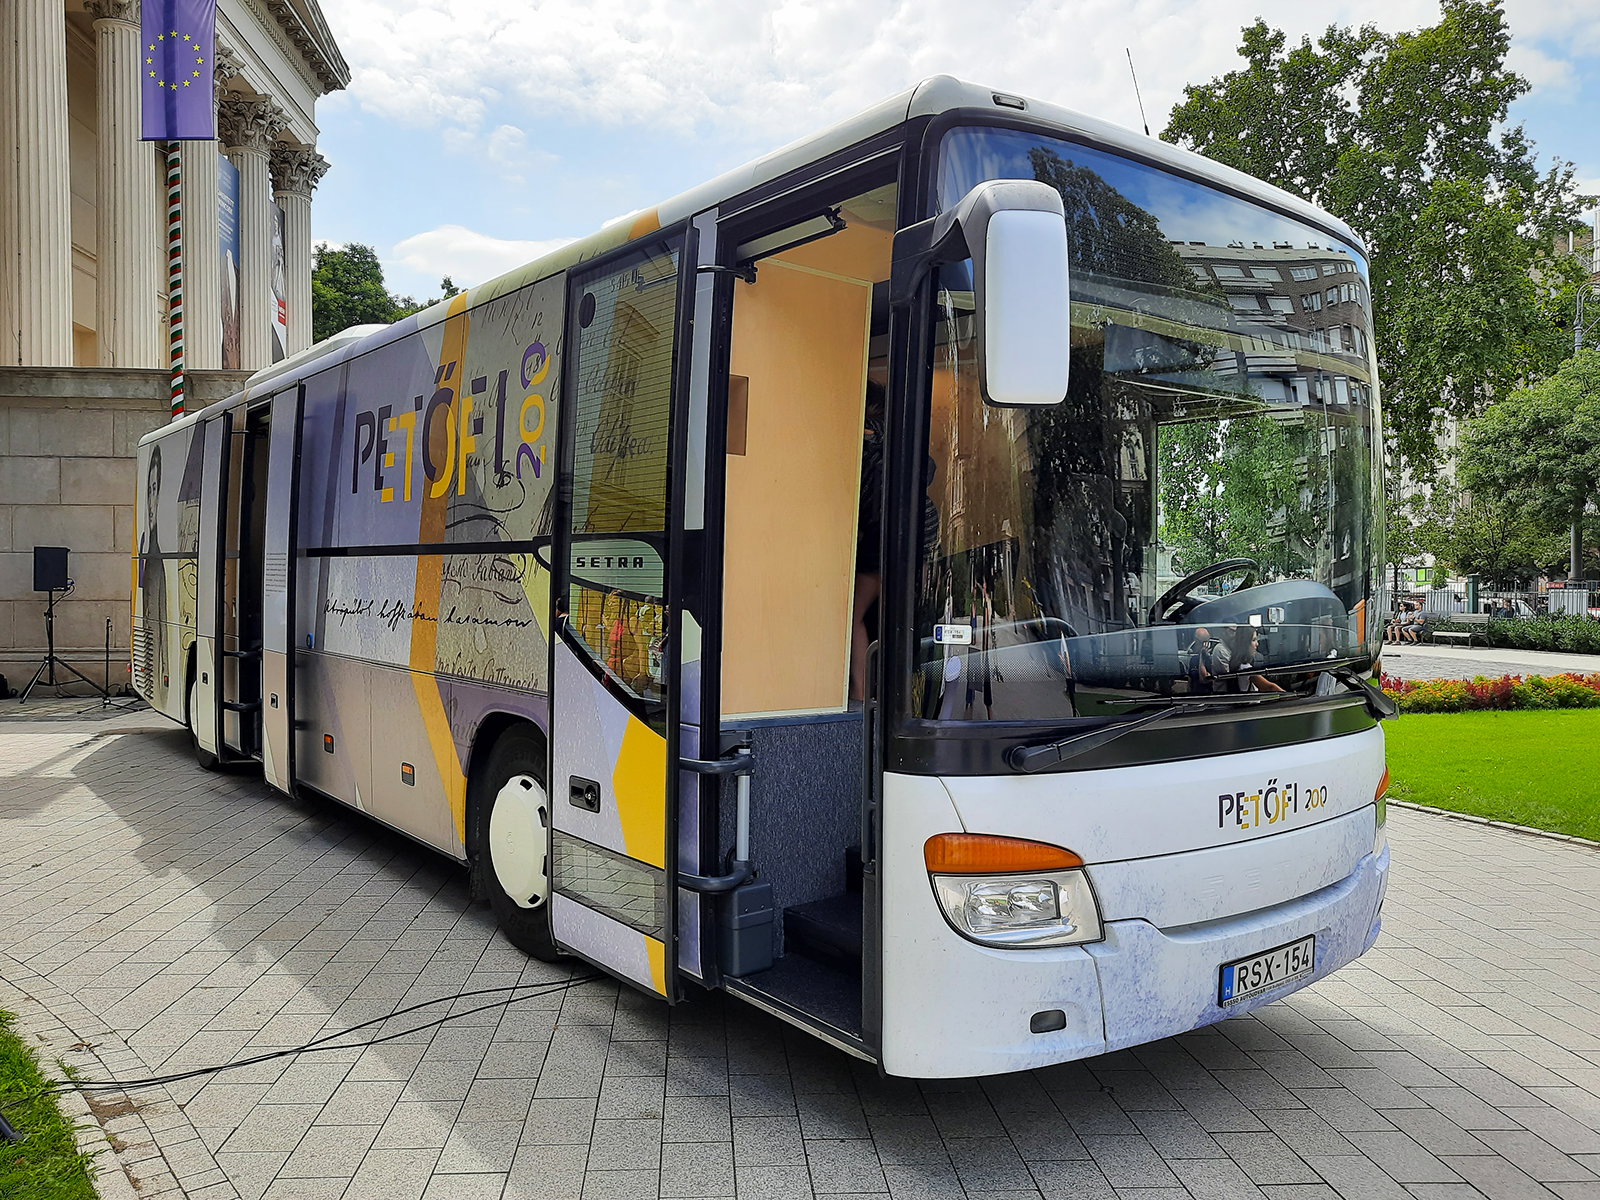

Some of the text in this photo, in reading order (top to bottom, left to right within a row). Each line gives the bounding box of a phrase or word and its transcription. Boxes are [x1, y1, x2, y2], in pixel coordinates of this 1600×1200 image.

[352, 360, 509, 503] PETŐFI
[516, 340, 551, 480] 200
[576, 556, 645, 569] SETRA
[1218, 777, 1328, 830] PETŐFI 200
[1224, 985, 1231, 997] H
[1237, 942, 1310, 993] RSX-154
